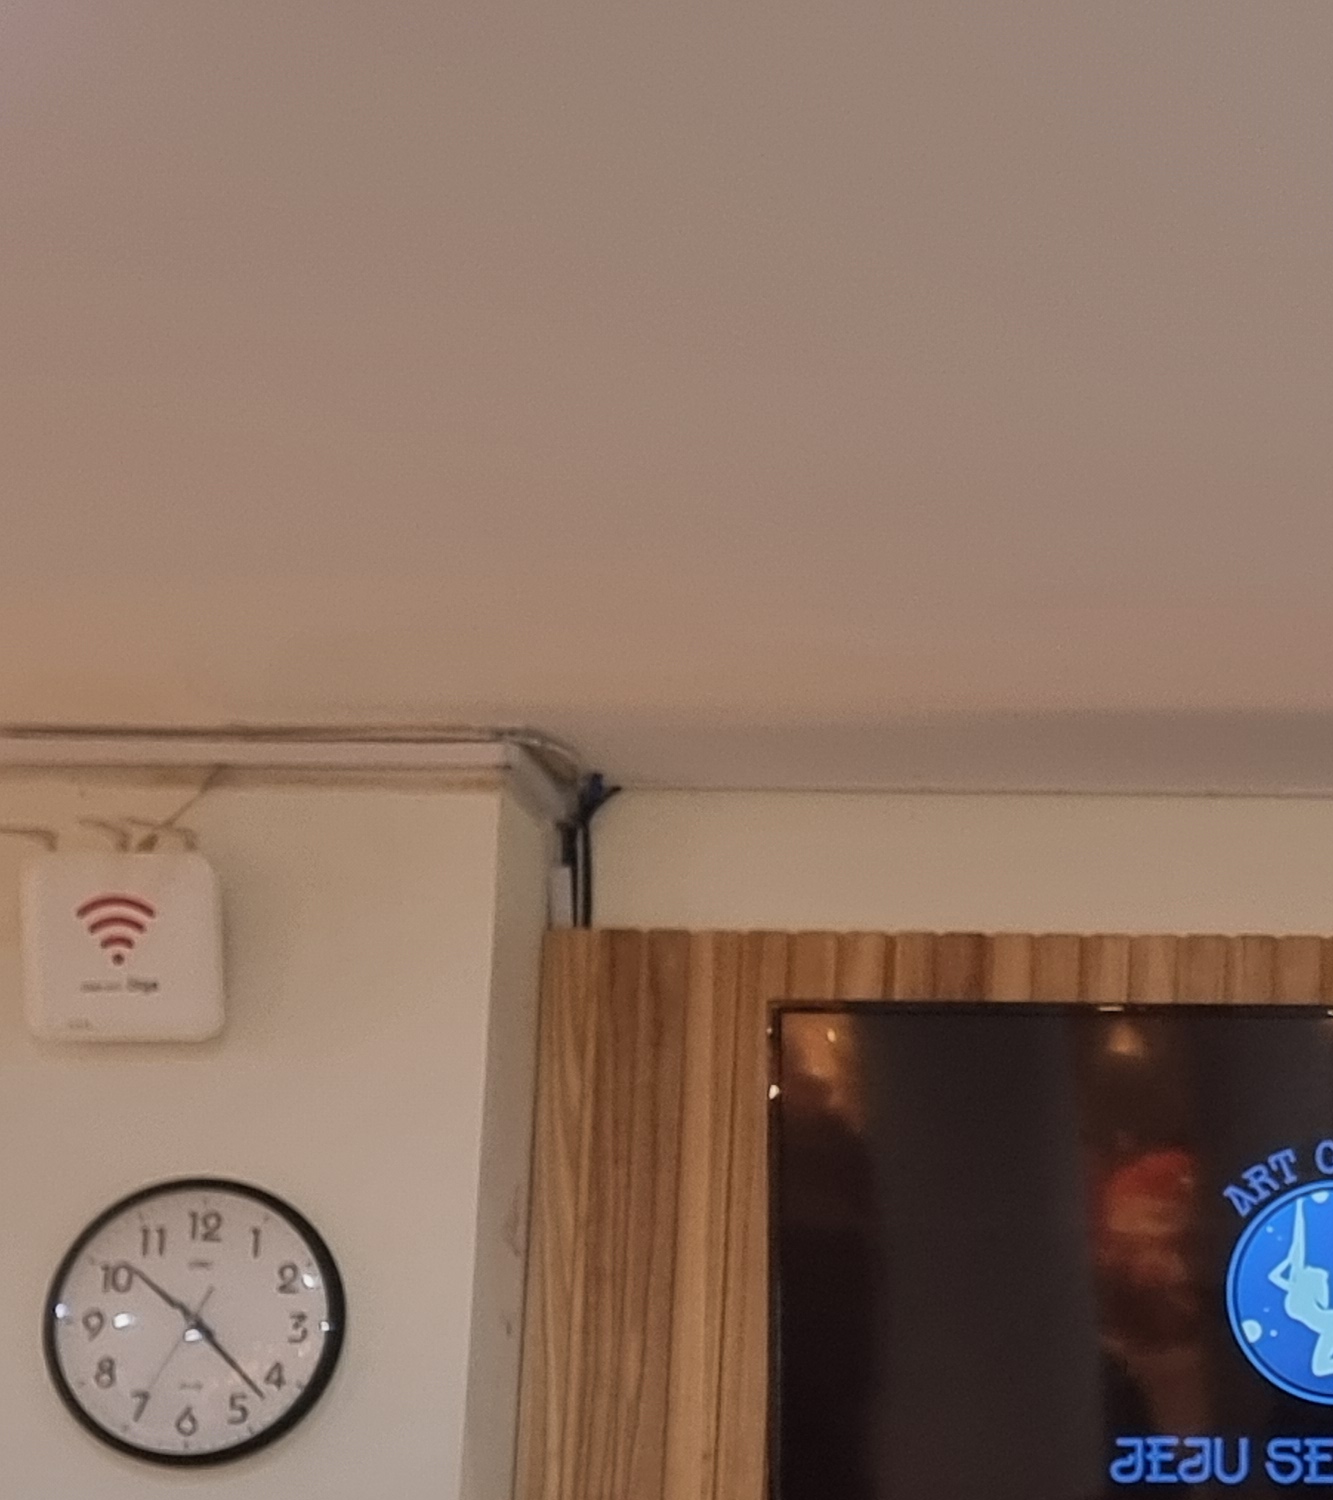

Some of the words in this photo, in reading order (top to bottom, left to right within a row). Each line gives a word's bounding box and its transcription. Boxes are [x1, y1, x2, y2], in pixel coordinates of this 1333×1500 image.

[1223, 1148, 1298, 1217] ART
[141, 1226, 165, 1257] 11
[188, 1211, 223, 1242] 12
[102, 1264, 133, 1293] 10
[277, 1264, 299, 1294] 2
[82, 1311, 104, 1342] 9
[287, 1314, 309, 1343] 3
[94, 1357, 117, 1389] 8
[264, 1362, 286, 1390] 4
[132, 1392, 150, 1422] 7
[175, 1407, 198, 1437] 6
[227, 1394, 250, 1424] 5
[1109, 1436, 1249, 1485] JEJU
